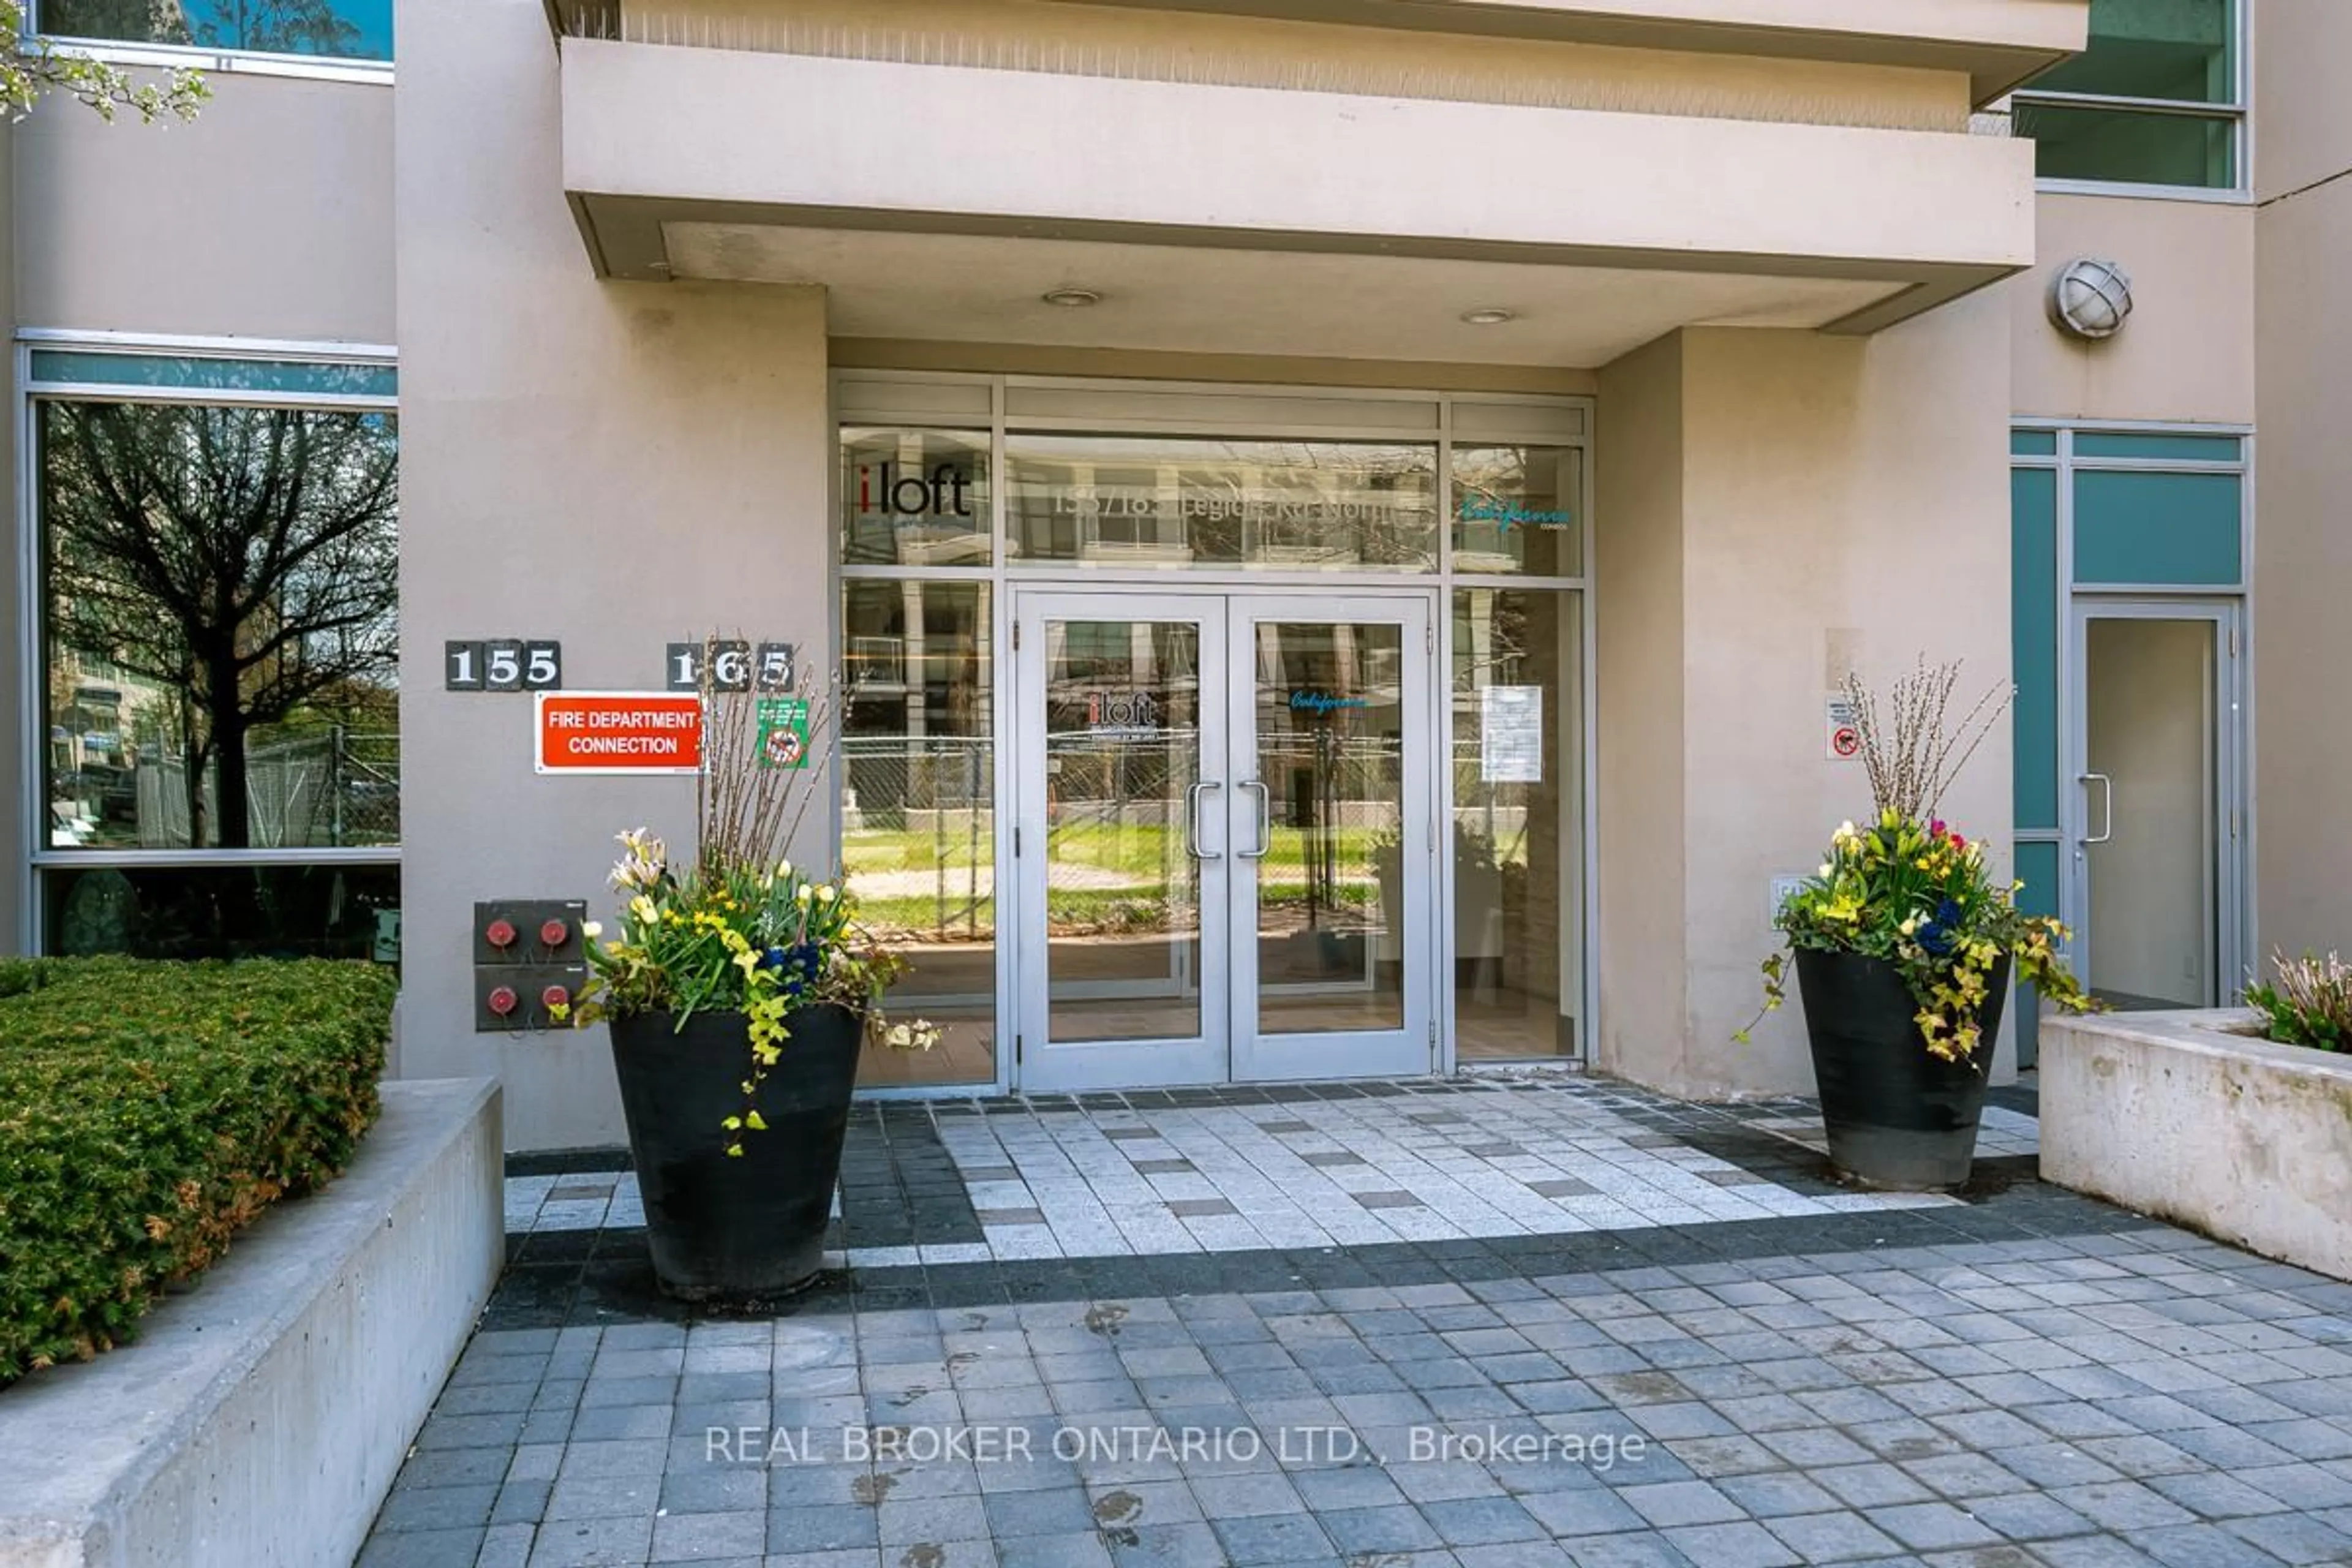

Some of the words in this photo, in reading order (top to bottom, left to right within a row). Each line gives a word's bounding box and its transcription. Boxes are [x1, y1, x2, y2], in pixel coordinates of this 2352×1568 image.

[451, 649, 557, 683] 155
[674, 650, 790, 684] 165
[549, 711, 585, 728] FIRE
[589, 711, 696, 728] DEPARTMENT
[568, 737, 677, 753] CONNECTION
